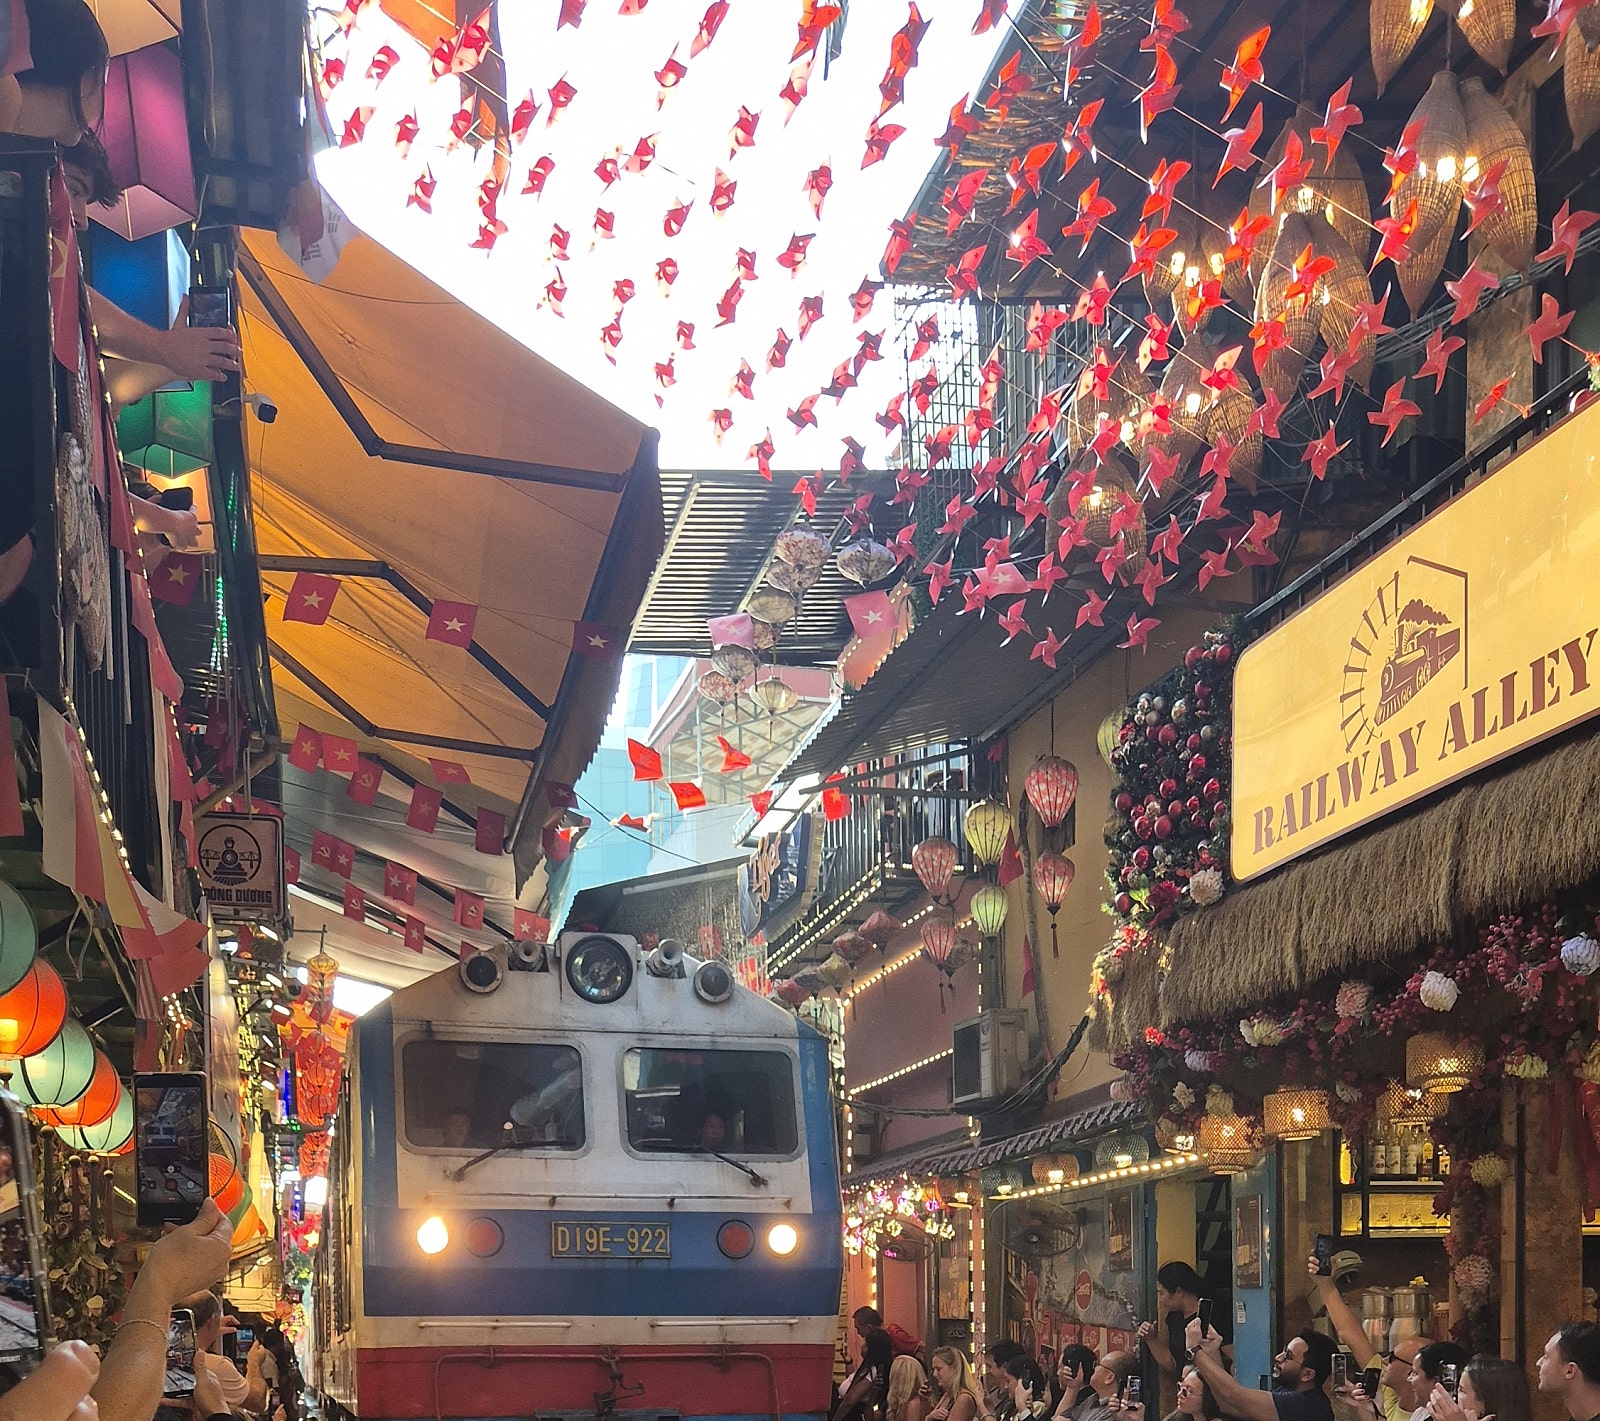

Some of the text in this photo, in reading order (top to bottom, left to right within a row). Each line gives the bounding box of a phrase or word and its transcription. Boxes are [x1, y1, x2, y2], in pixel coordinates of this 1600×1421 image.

[1252, 627, 1599, 855] RAILWAY ALLEY
[557, 1226, 667, 1253] D19E-922
